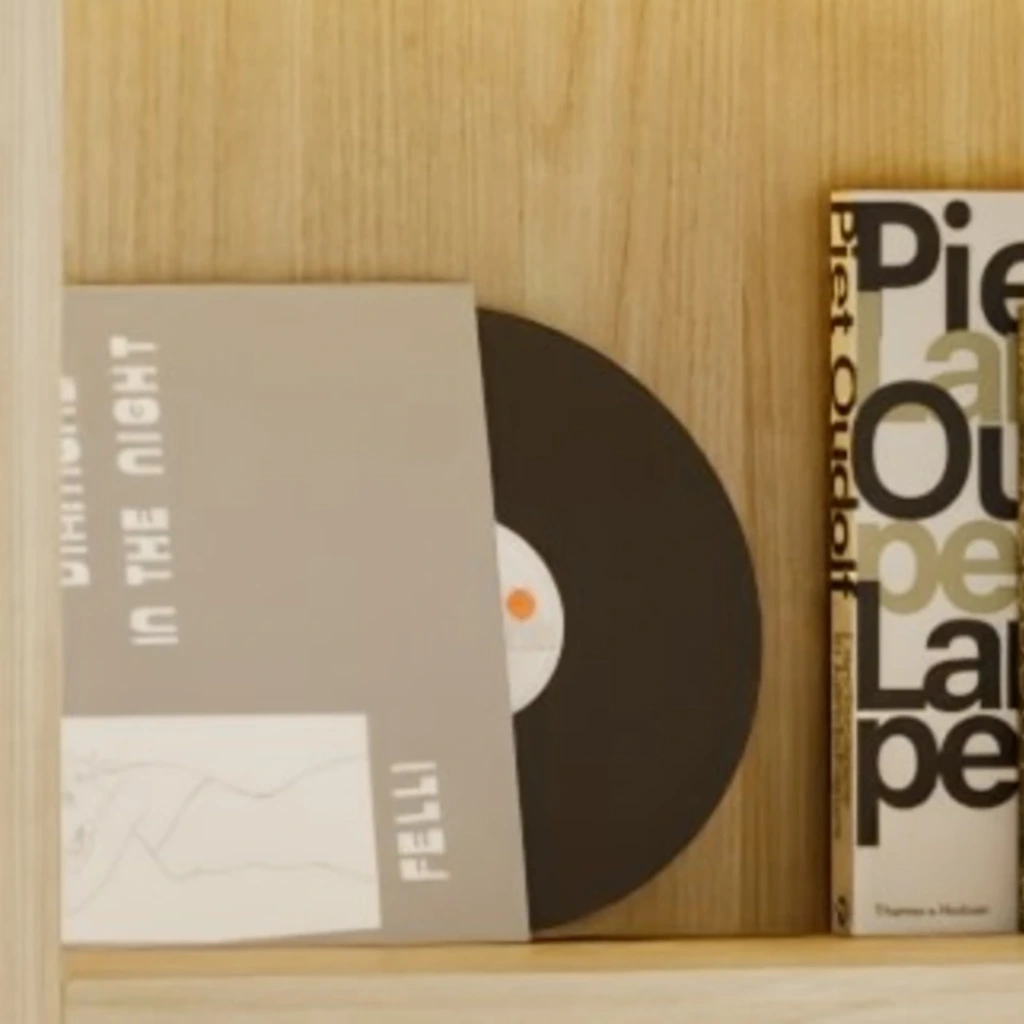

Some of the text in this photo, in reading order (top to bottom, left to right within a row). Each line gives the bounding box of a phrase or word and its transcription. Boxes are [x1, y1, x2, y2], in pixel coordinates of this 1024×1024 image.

[831, 202, 858, 334] Piet
[831, 355, 860, 598] Oudolf
[390, 761, 450, 882] FELLI
